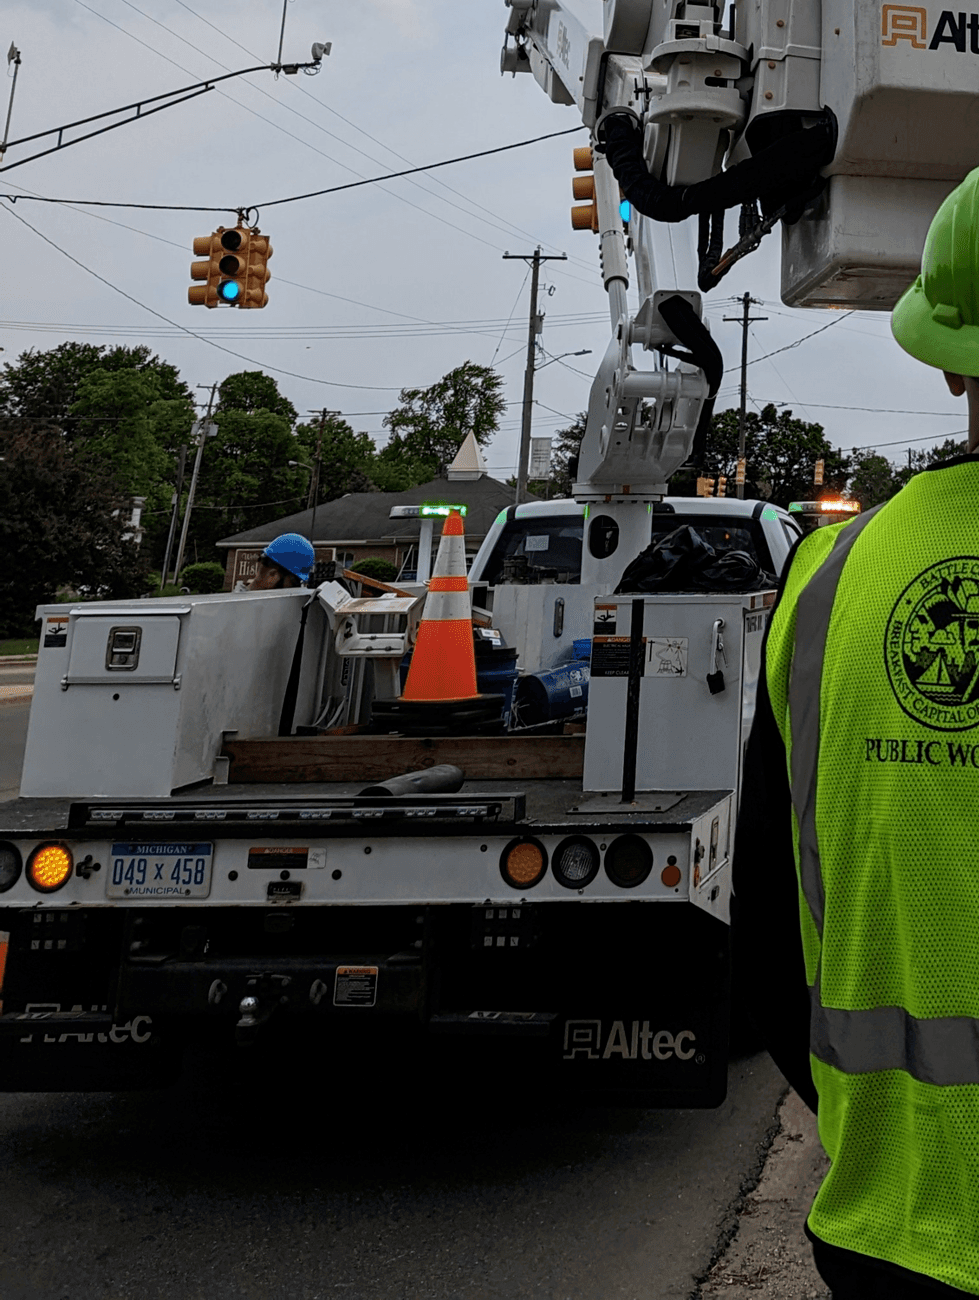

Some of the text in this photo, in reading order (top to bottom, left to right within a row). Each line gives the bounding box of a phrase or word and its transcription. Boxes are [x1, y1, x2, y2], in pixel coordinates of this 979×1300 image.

[920, 562, 969, 589] BATTLE
[912, 699, 965, 723] CAPITAL
[865, 738, 942, 766] PUBLIC
[136, 845, 188, 854] MICHIGAN
[112, 858, 147, 885] 049
[170, 858, 205, 885] 458
[129, 887, 184, 895] MUNICIPAL
[602, 1020, 697, 1060] Altec
